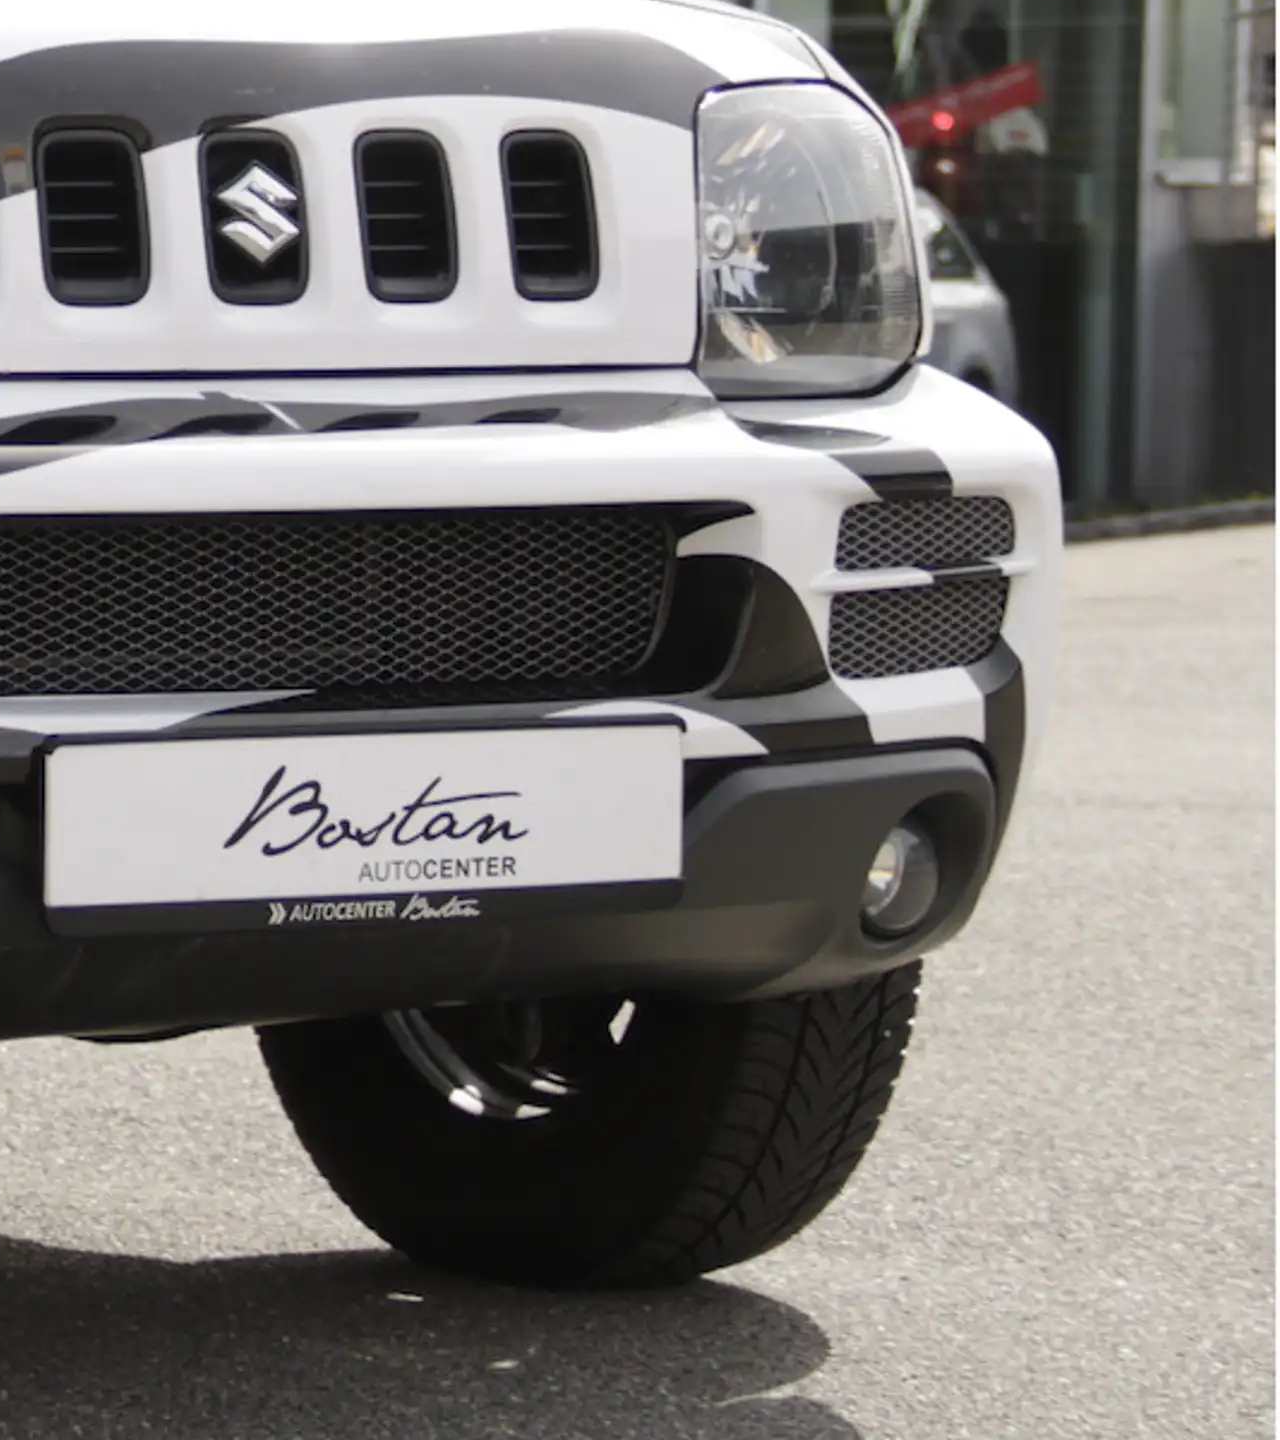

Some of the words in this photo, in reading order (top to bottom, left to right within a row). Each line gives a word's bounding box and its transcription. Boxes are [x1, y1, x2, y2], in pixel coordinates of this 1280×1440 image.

[223, 764, 529, 856] Bostan
[358, 855, 517, 883] AUTOCENTER
[290, 899, 396, 922] AUTOCENTER
